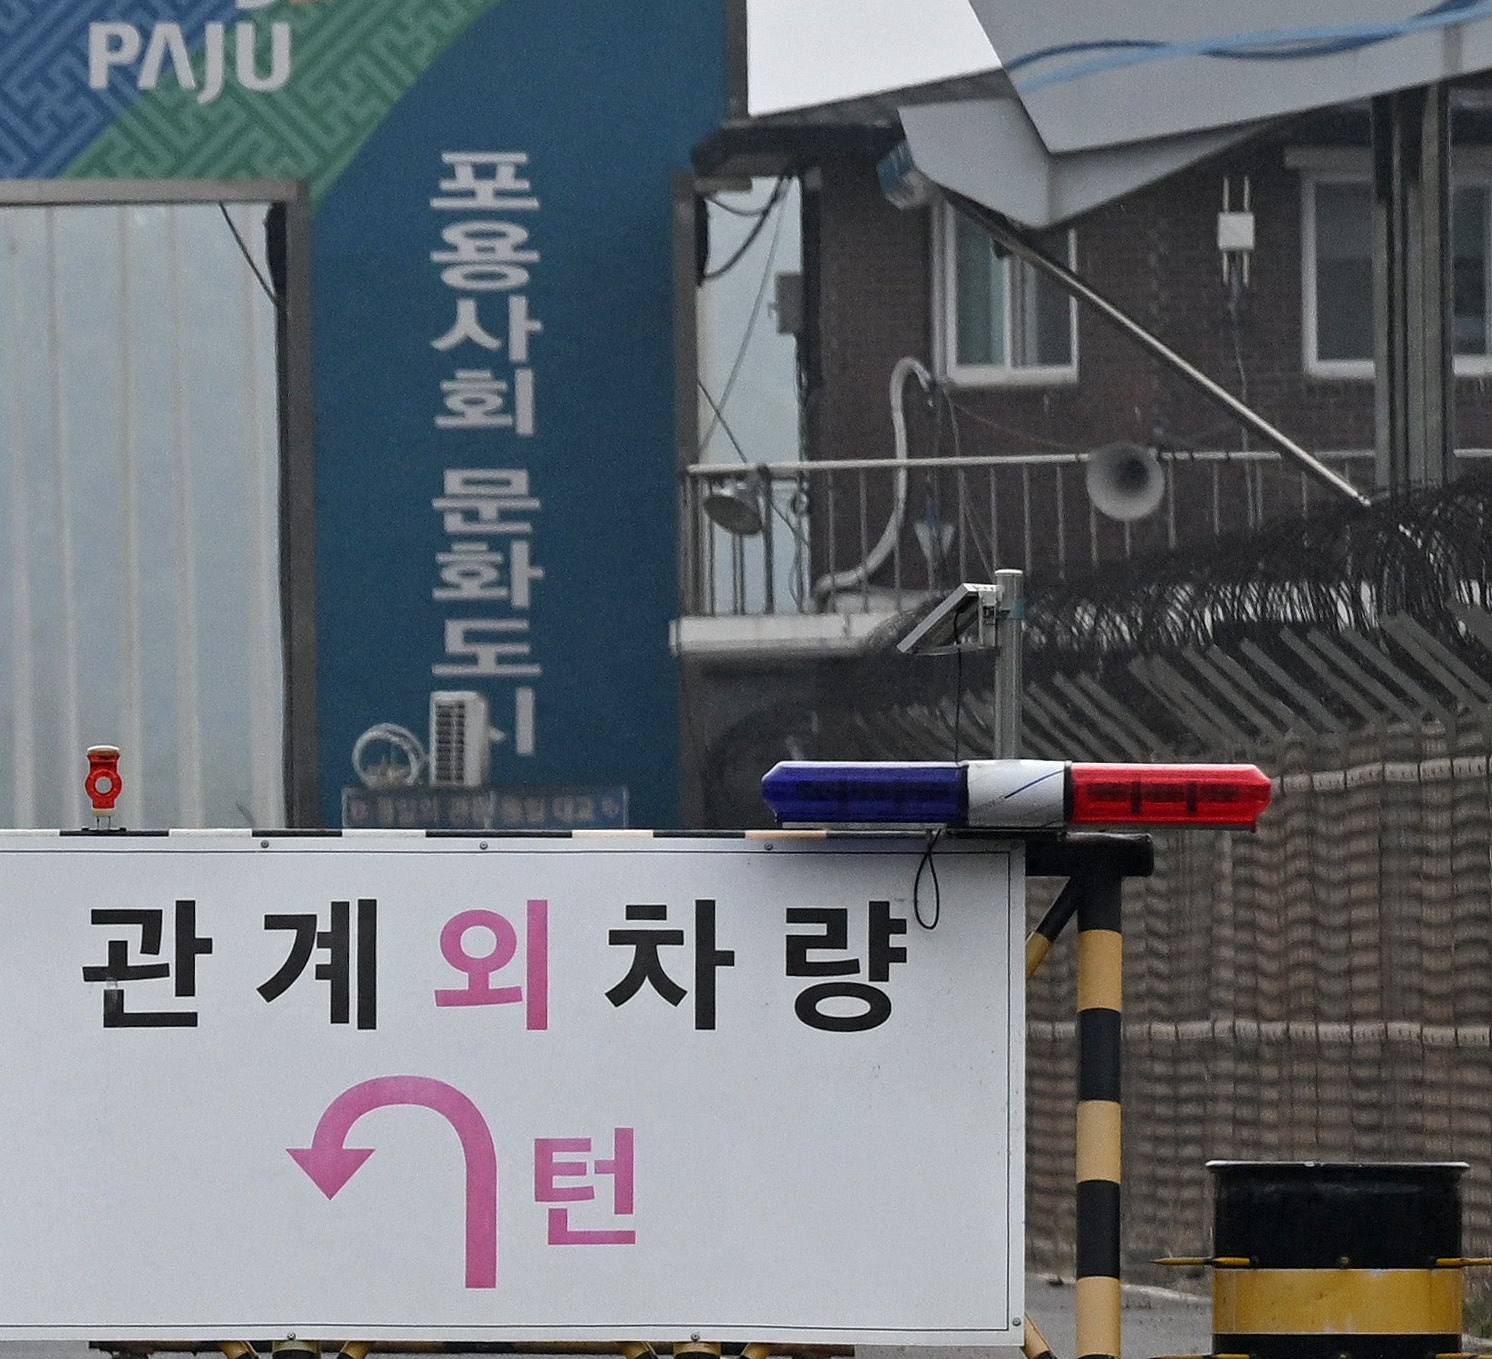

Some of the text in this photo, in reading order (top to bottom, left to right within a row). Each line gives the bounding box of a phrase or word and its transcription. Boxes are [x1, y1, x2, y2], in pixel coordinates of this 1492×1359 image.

[88, 22, 292, 104] PAJU
[429, 151, 544, 436] 포용사회
[534, 1127, 637, 1246] 턴
